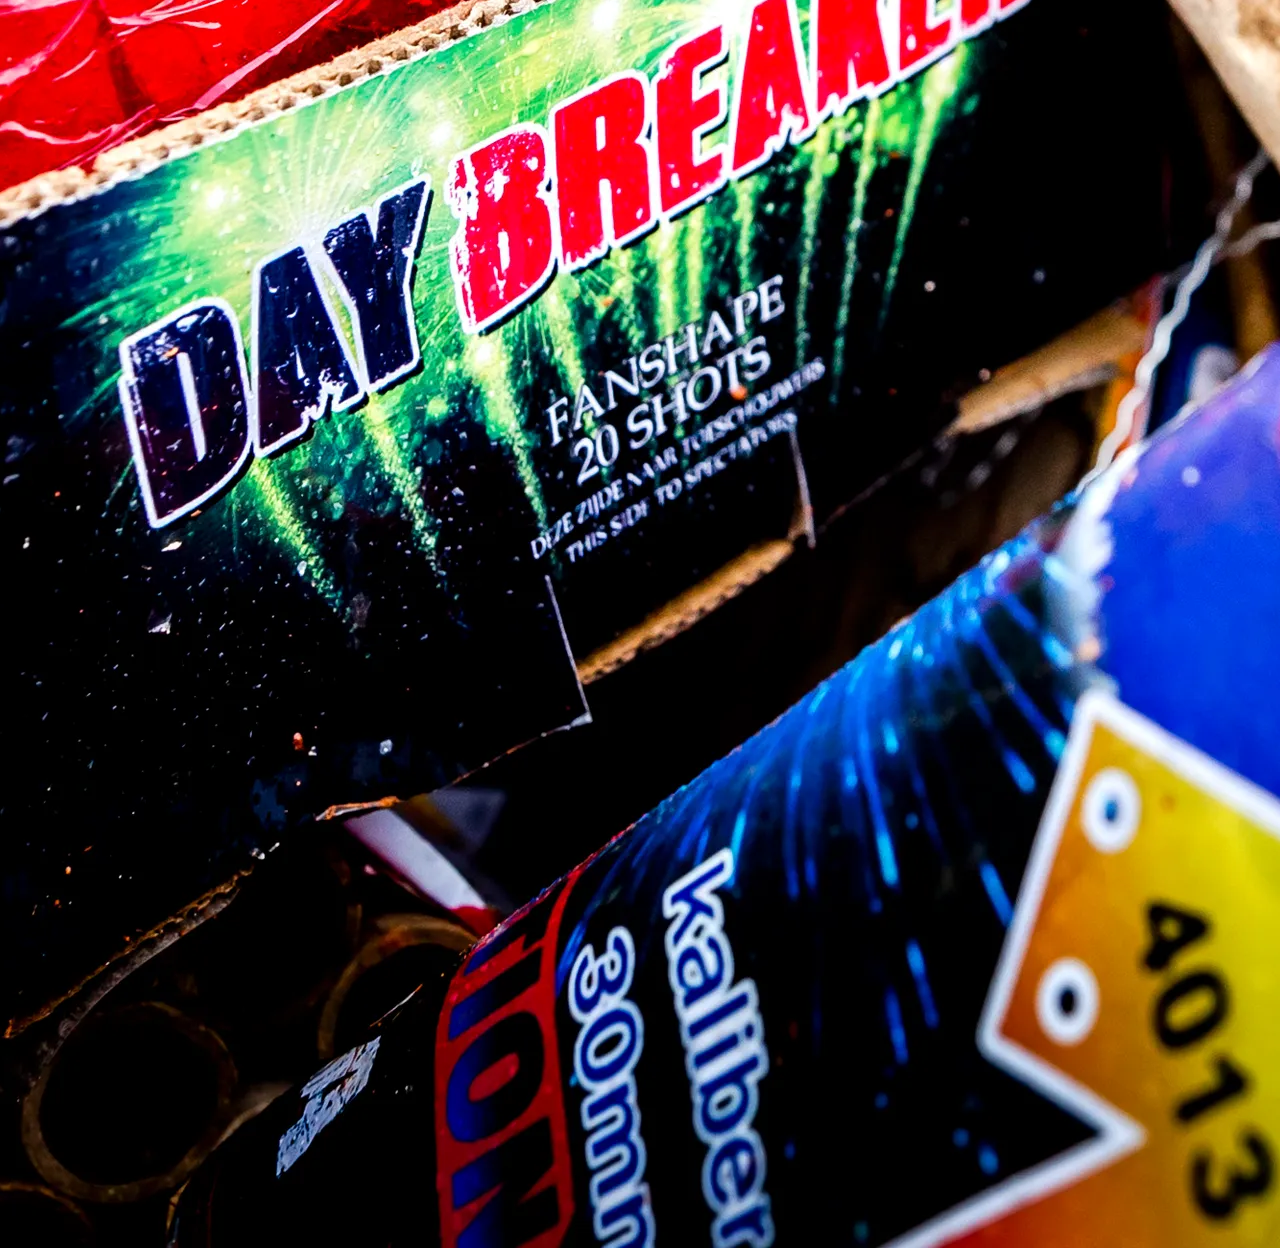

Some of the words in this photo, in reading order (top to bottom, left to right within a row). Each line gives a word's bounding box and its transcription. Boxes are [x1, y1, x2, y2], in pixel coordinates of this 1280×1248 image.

[119, 174, 431, 528] DAY
[545, 274, 786, 447] FANSHAPE
[573, 423, 620, 487] 20
[626, 335, 771, 450] SHOTS
[530, 511, 575, 559] DEZE
[565, 528, 608, 563] THIS
[653, 477, 684, 506] TO
[1141, 899, 1278, 1228] 4013
